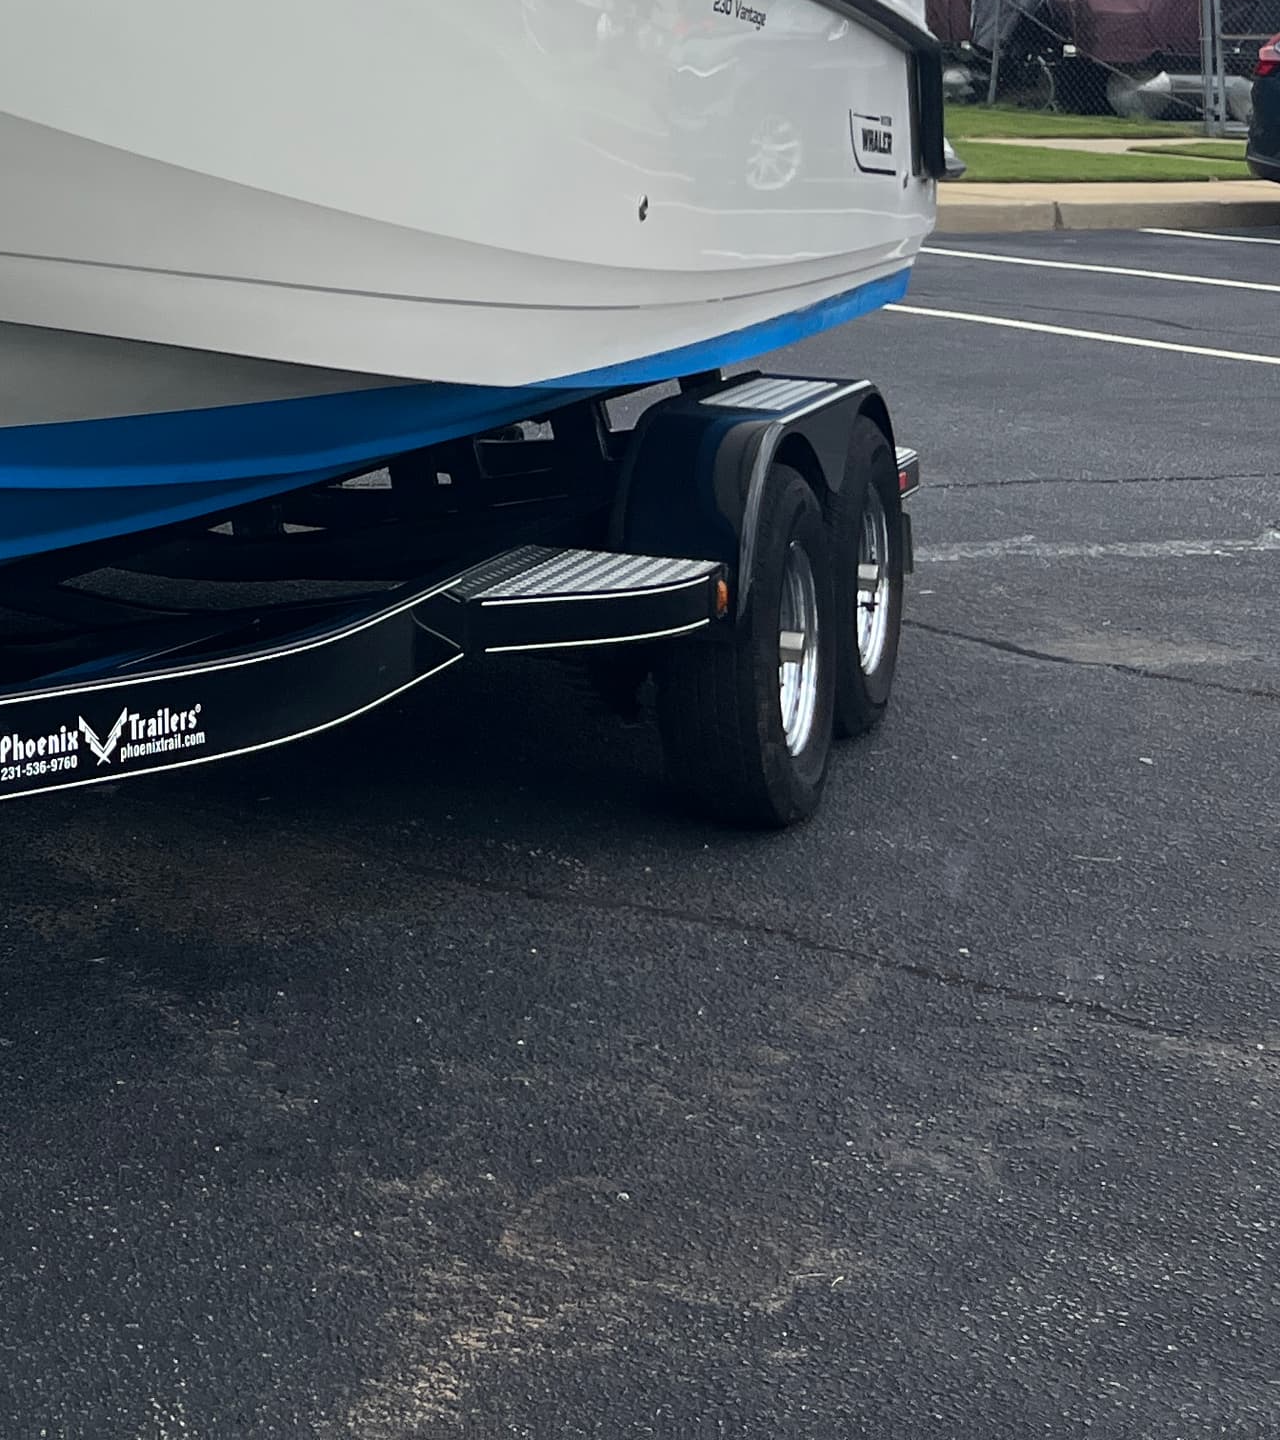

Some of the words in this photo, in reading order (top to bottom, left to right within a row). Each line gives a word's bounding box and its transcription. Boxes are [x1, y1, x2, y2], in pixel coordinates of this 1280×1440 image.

[861, 128, 893, 155] WHALER
[0, 725, 79, 764] Phoenix
[120, 731, 206, 763] phoenixtrail.com
[0, 754, 78, 782] 231-536-9760
